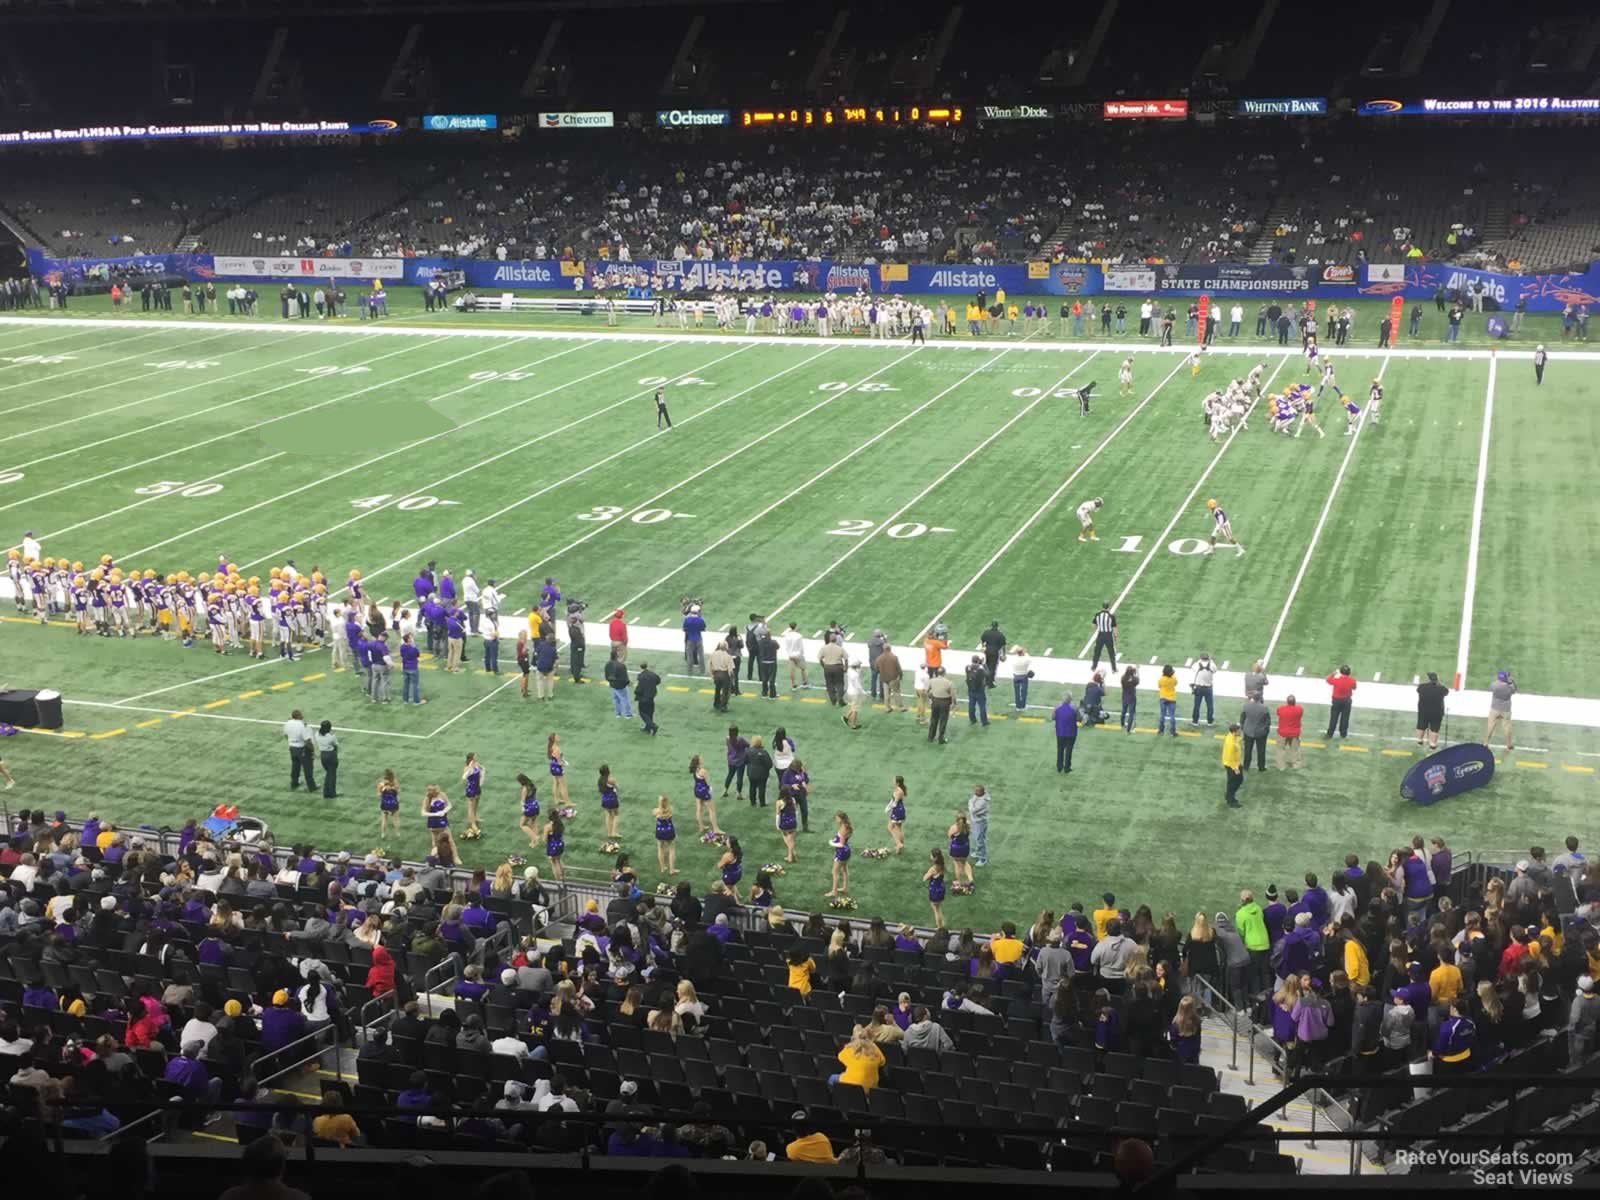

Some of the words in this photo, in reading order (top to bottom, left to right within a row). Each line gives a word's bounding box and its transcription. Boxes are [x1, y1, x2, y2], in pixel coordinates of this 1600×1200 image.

[1245, 101, 1289, 113] WHITNEY
[1292, 100, 1319, 112] BANK
[1515, 98, 1548, 109] 2016
[563, 113, 607, 124] Chevron
[669, 110, 724, 125] Ochsner
[911, 107, 919, 120] 0
[983, 106, 1011, 118] Winn
[1019, 105, 1048, 118] Dixie
[449, 116, 487, 128] Allstate
[494, 265, 551, 282] Allstate
[828, 265, 869, 278] Allstate
[929, 270, 996, 287] Allstate
[1161, 279, 1201, 290] STATE
[1204, 279, 1309, 290] CHAMPIONSHIPS
[134, 481, 224, 498] 50
[350, 494, 439, 511] 40
[576, 505, 673, 523] 30
[825, 519, 927, 539] 20
[1111, 535, 1211, 555] 10
